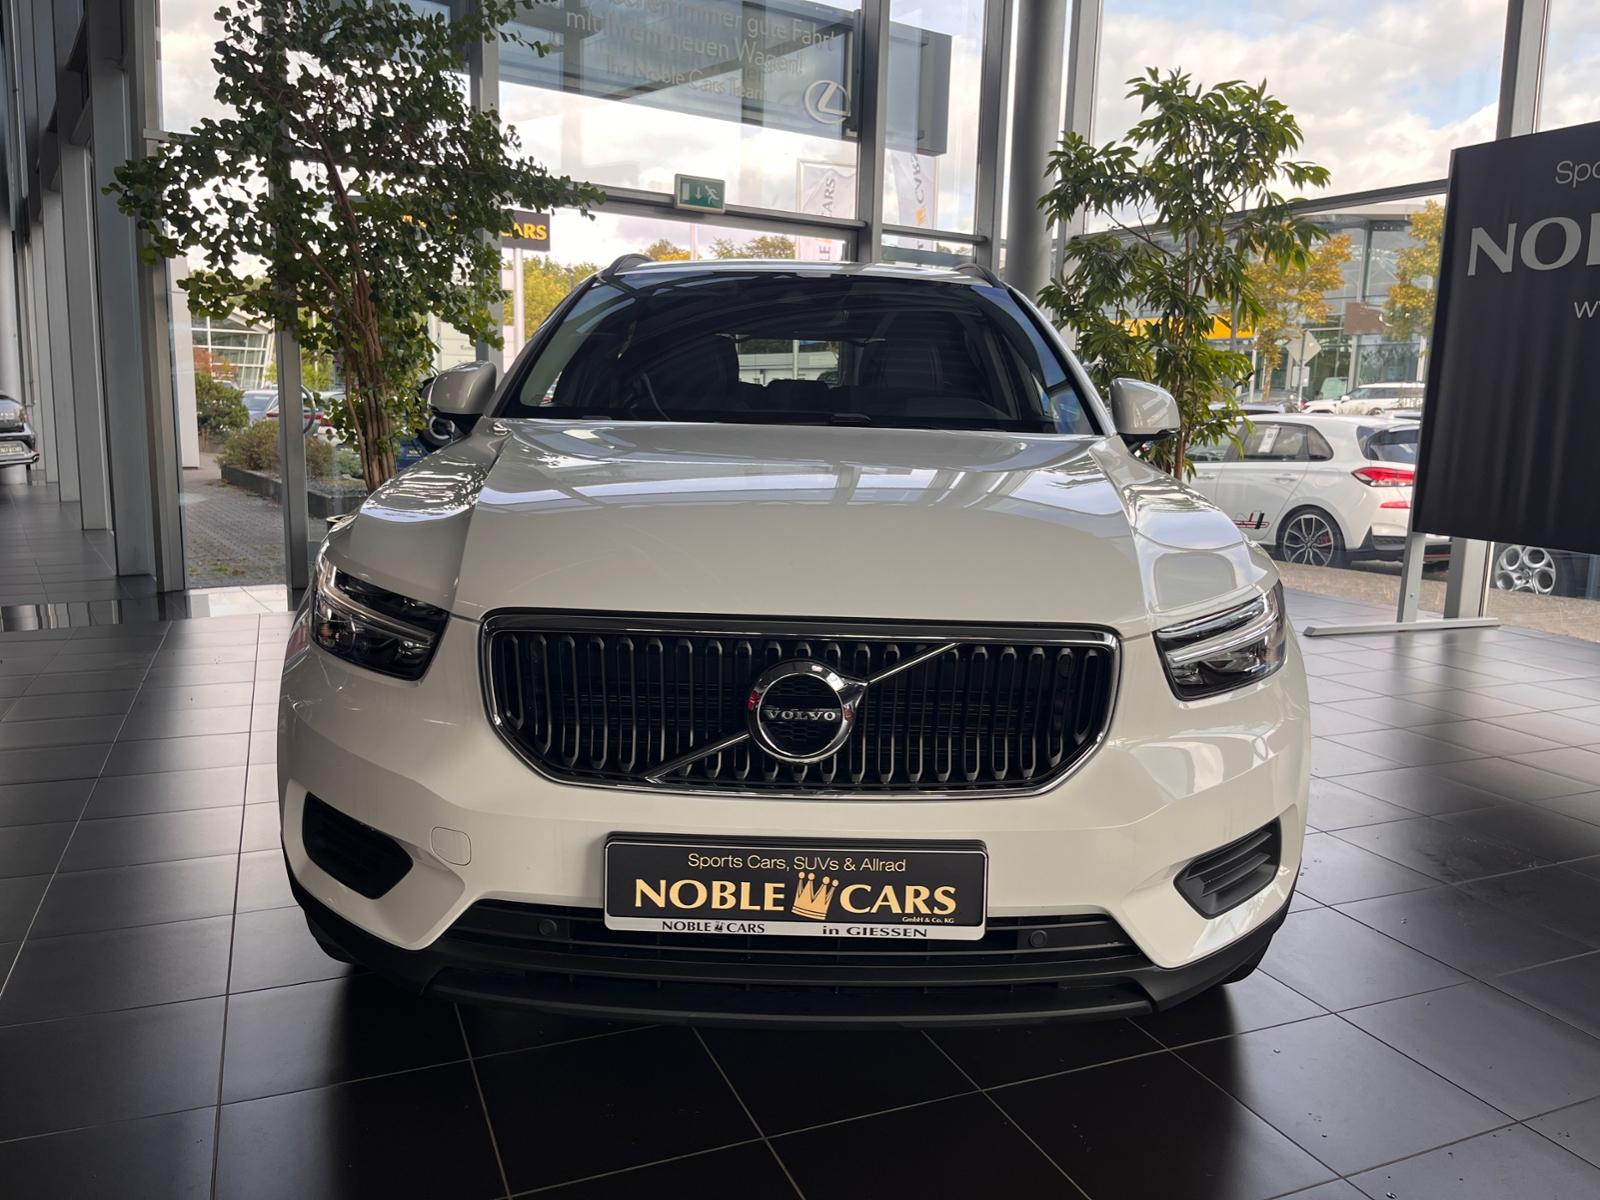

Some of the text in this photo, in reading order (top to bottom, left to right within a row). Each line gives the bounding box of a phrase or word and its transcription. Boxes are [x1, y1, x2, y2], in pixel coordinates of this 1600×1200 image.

[566, 11, 600, 32] mit
[747, 17, 787, 39] gute
[792, 18, 835, 51] Fahrt
[821, 176, 836, 217] ARS
[1574, 300, 1600, 319] w
[768, 711, 836, 721] VOLVO
[687, 852, 906, 872] Sports Cars, SUVs & Allrad
[635, 878, 957, 915] NOBLE CARS
[662, 920, 928, 938] NOBLE CARS in GIESSEN
